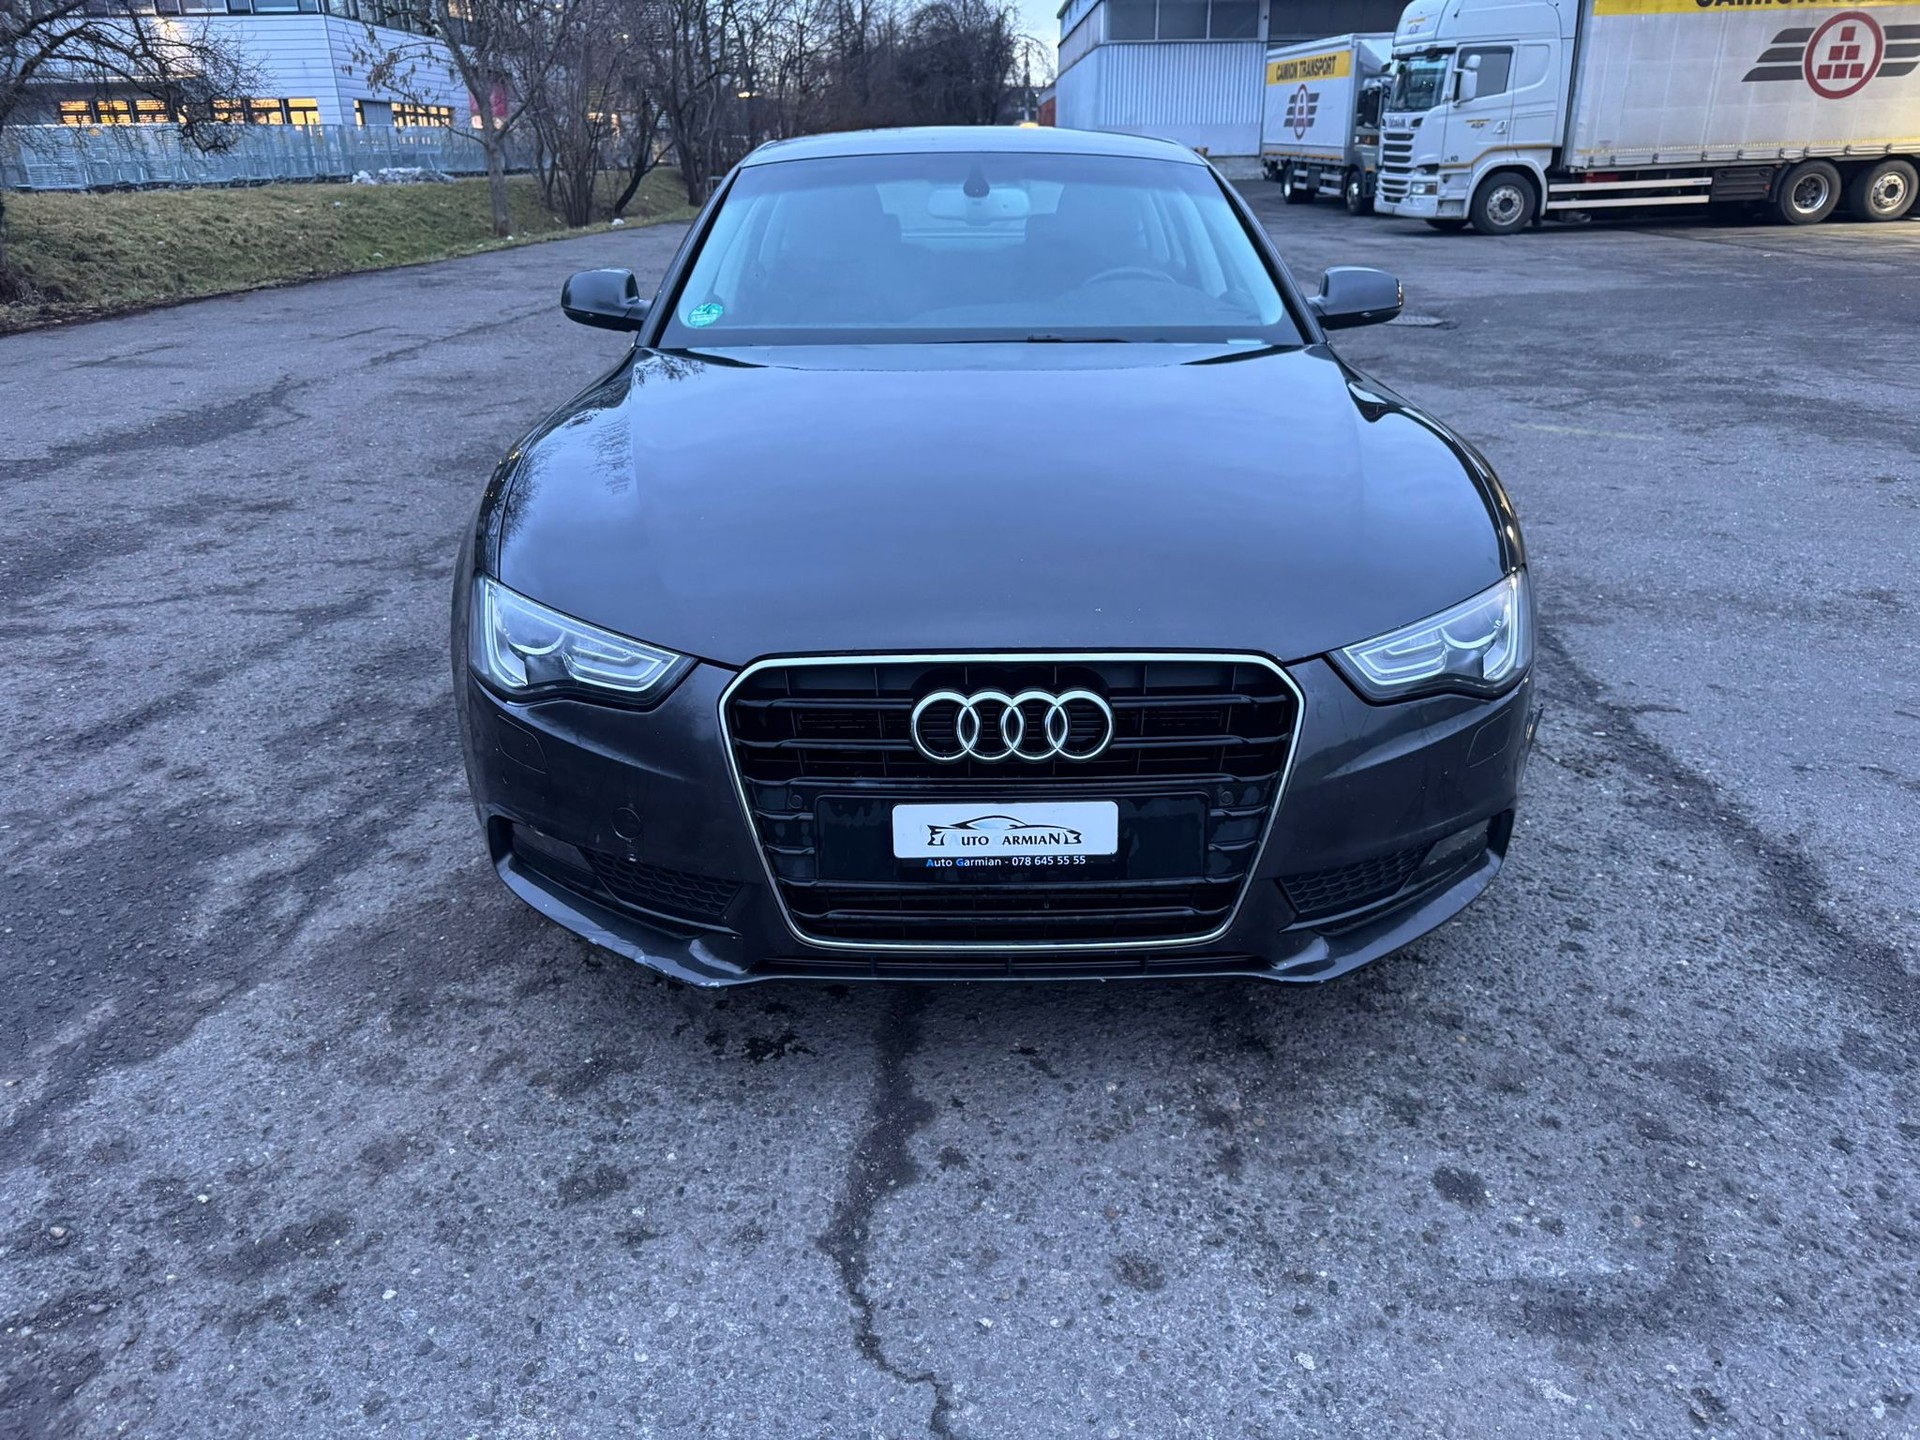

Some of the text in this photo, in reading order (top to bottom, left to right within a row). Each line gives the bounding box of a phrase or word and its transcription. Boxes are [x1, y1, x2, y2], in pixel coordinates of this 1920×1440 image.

[1299, 55, 1337, 78] TRANSPORT
[926, 858, 953, 867] Auto
[956, 857, 1002, 867] Garmian
[1011, 856, 1032, 866] 078
[1034, 856, 1054, 866] 645
[1057, 855, 1070, 865] 55
[1073, 855, 1086, 865] 55
